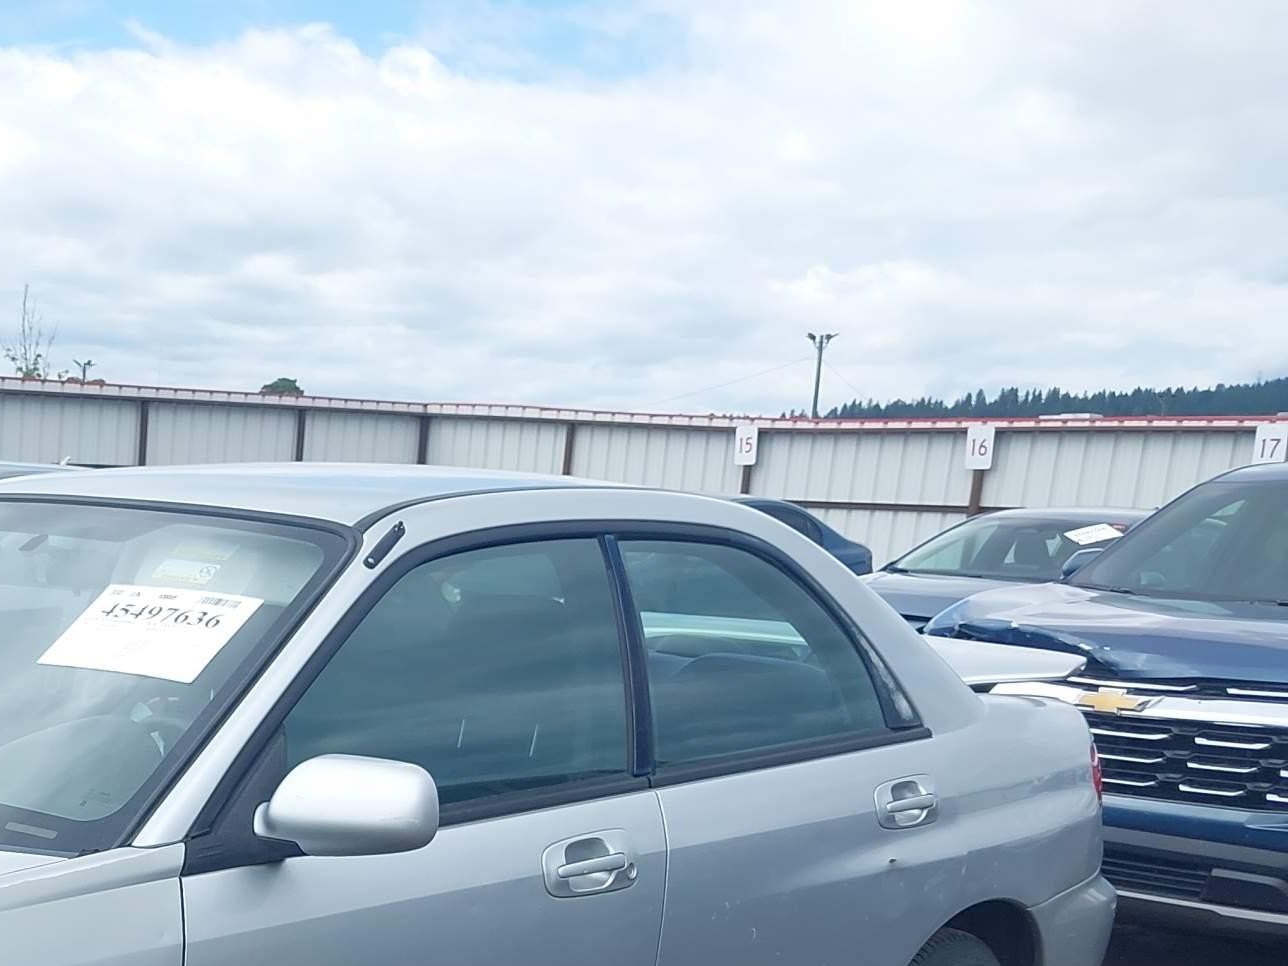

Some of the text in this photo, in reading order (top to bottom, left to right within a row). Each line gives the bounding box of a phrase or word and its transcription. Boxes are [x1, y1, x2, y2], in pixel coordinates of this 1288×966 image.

[739, 437, 753, 454] 15
[971, 438, 988, 457] 16
[1260, 438, 1281, 459] 17
[101, 603, 224, 628] 45497636
